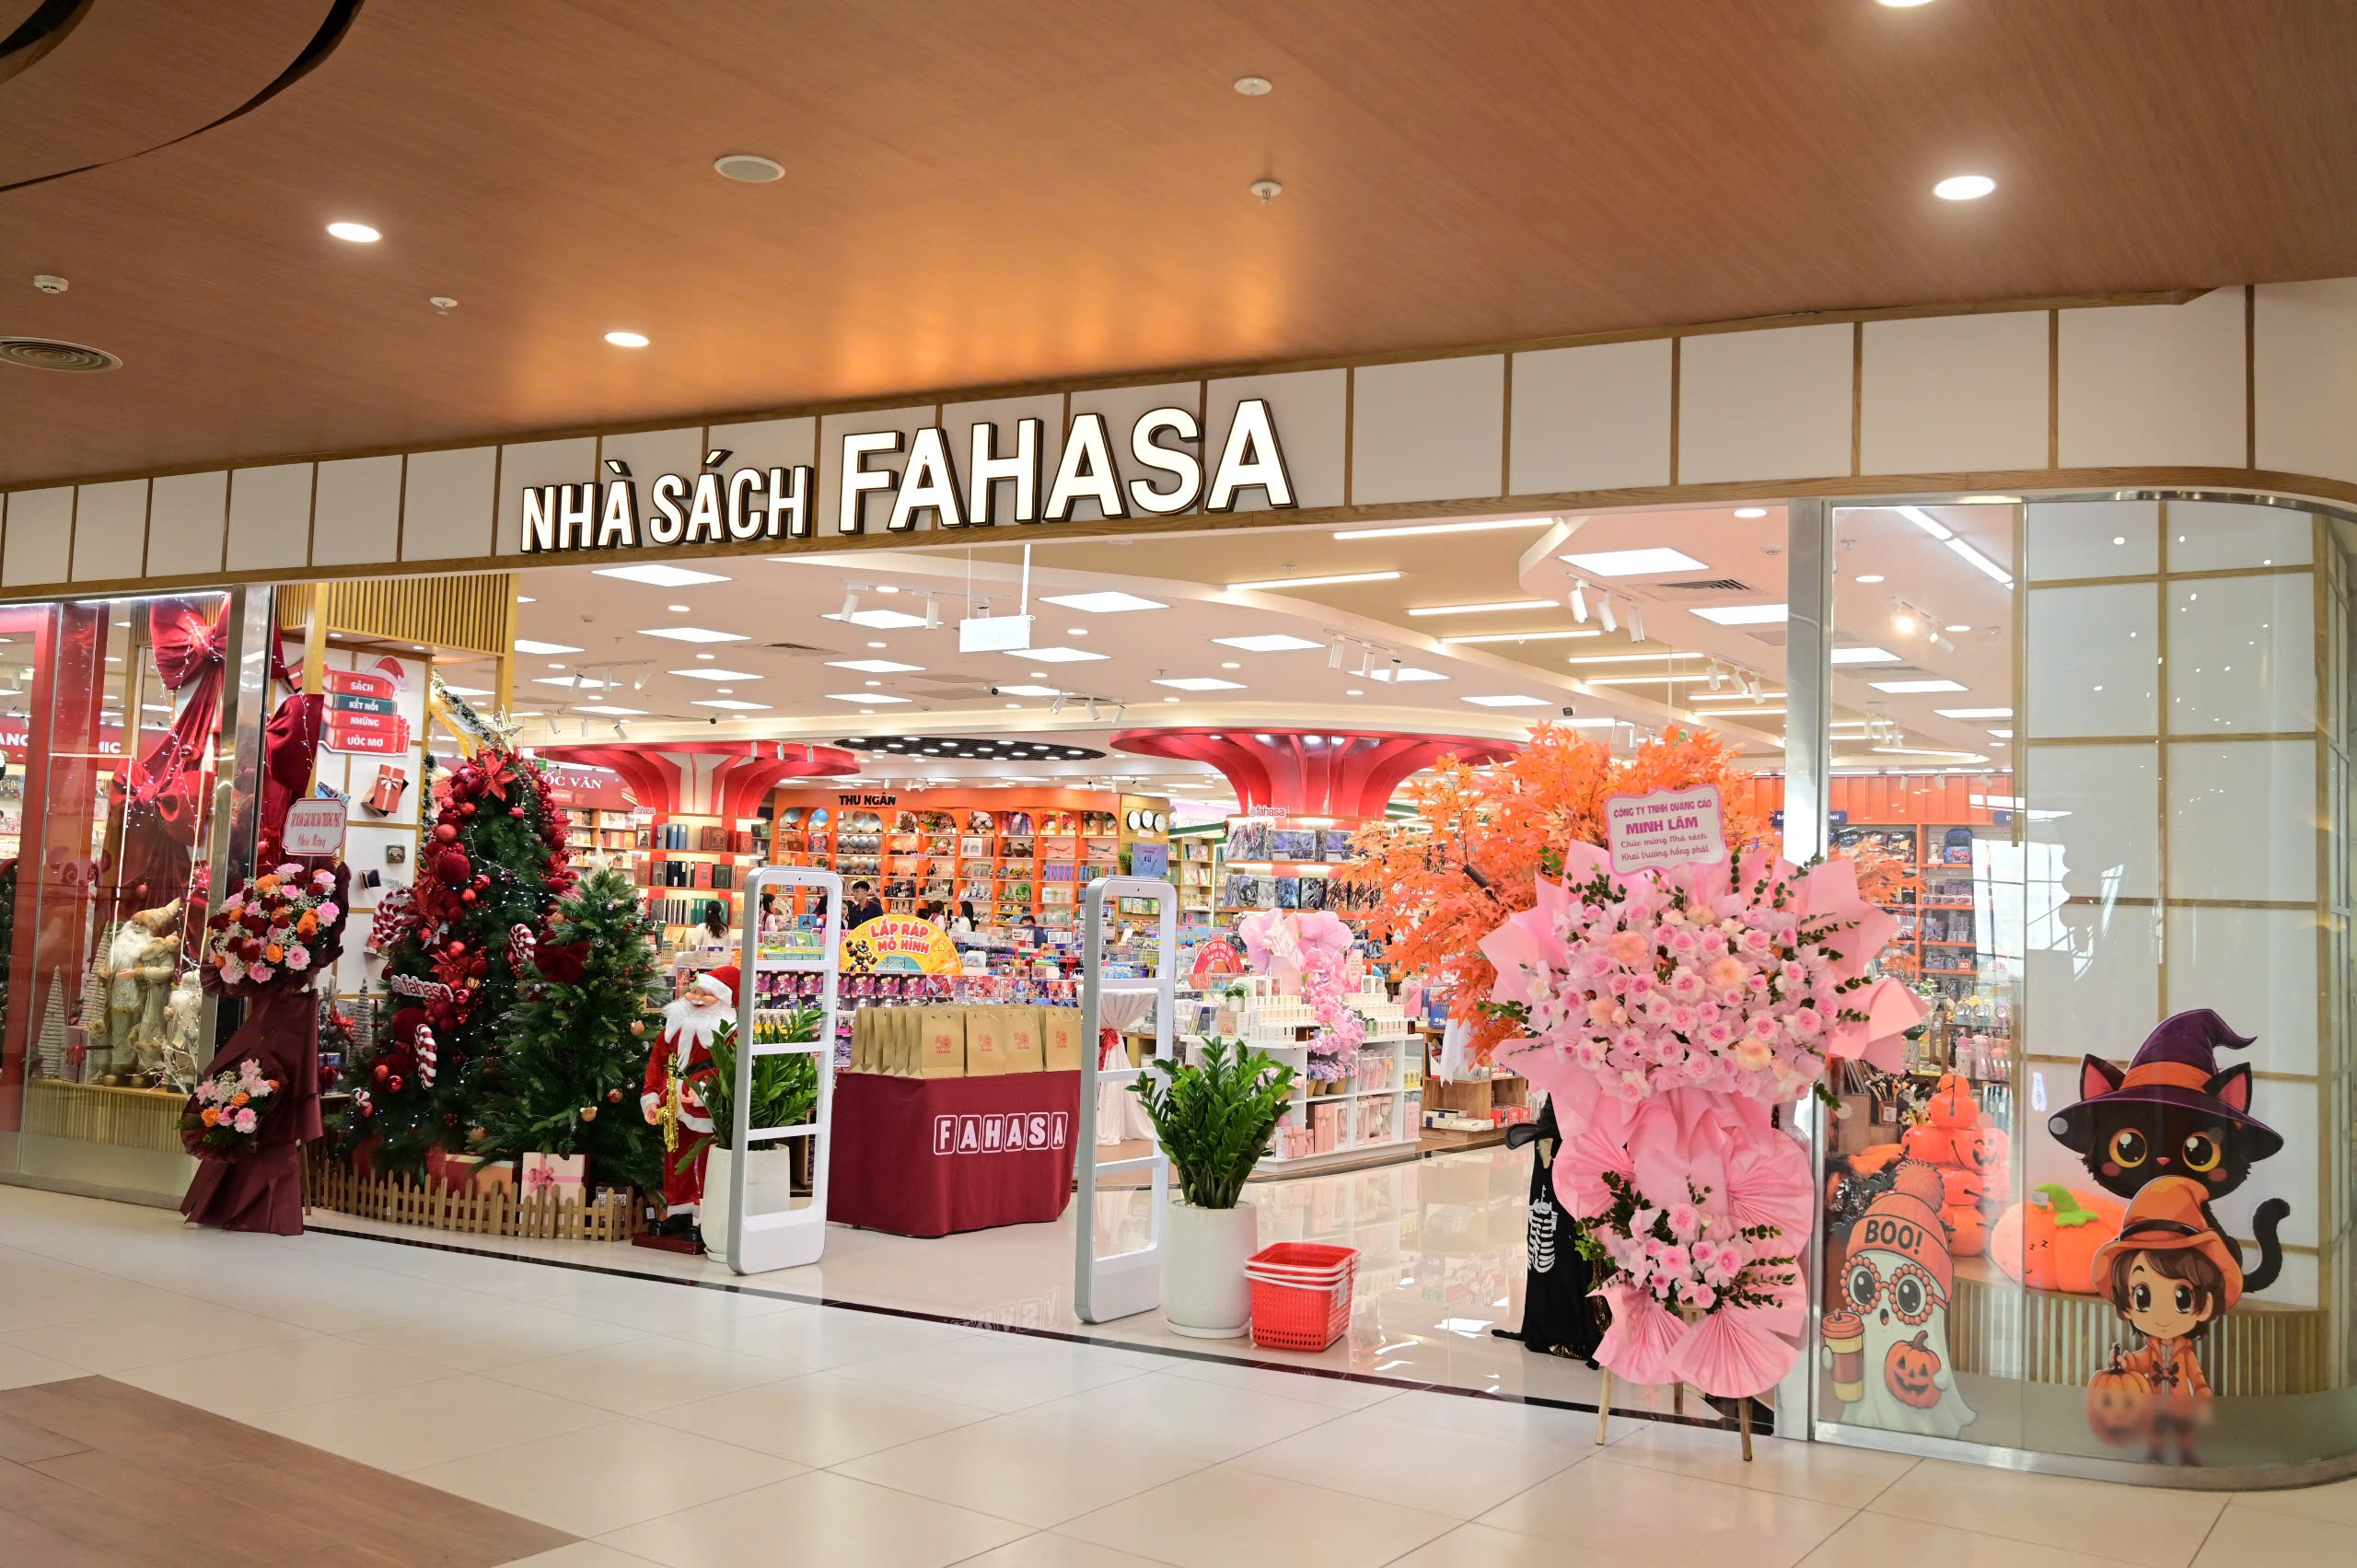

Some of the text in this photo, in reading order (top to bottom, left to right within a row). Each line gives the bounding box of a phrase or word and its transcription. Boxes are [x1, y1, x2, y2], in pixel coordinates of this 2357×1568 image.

[521, 398, 1298, 553] NHÀ SÁCH FAHASA
[351, 680, 374, 692] SÁCH
[349, 698, 378, 711] KẾT NỐI
[351, 716, 379, 726] NHỮNG
[540, 771, 602, 789] ỐC VĂN
[839, 792, 897, 806] THU NGÂN
[1257, 806, 1284, 817] fahasa
[1613, 807, 1634, 818] CÔNG
[1647, 804, 1668, 814] TNHH
[1626, 816, 1699, 834] MINH LÂM
[870, 917, 929, 938] LẮP RÁP
[877, 937, 930, 954] MÔ HÌNH
[939, 1117, 1063, 1150] FAHASA
[1864, 1219, 1923, 1255] BOO!
